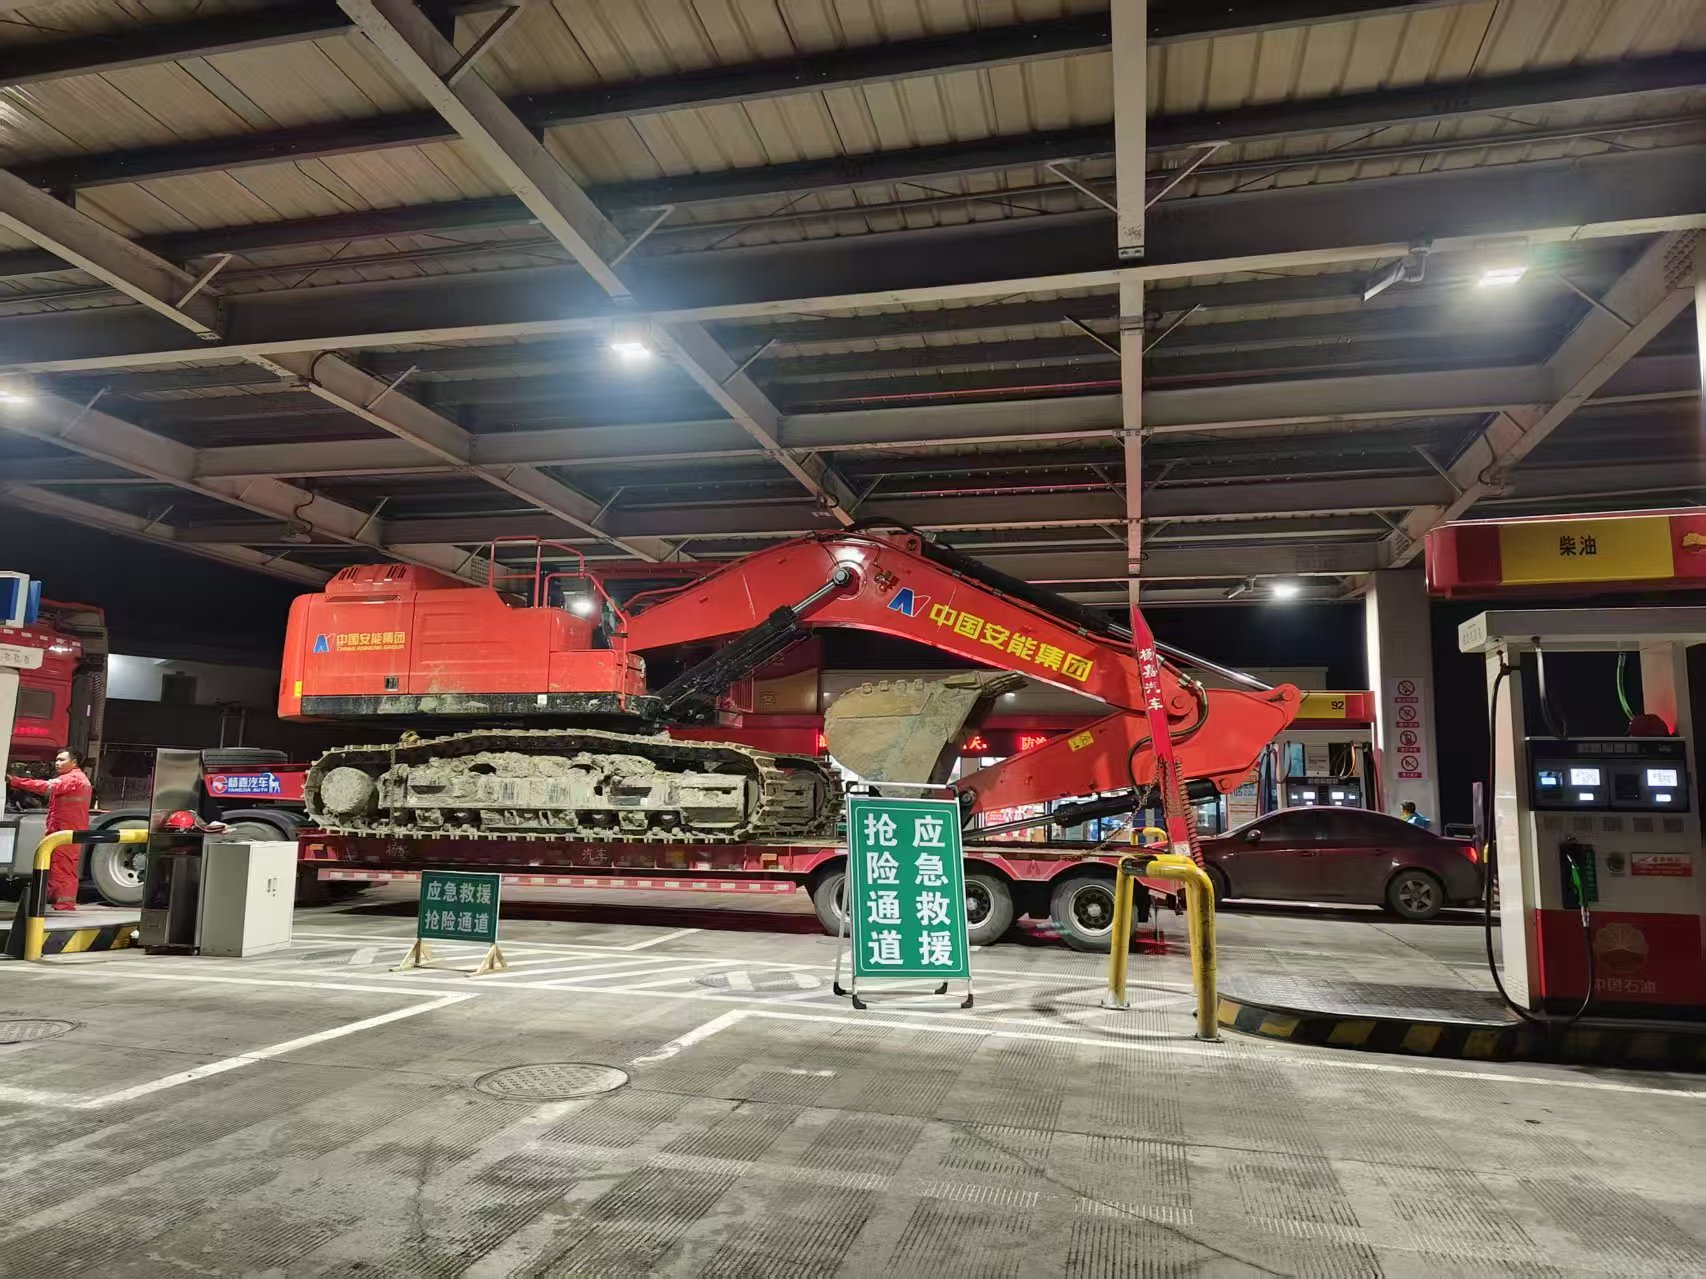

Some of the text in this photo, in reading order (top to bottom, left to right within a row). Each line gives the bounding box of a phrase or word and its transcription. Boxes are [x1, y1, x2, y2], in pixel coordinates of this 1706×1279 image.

[1559, 535, 1597, 557] 柴油
[336, 631, 405, 646] 中国安能集团
[929, 604, 1094, 683] 中国安能集团
[1331, 700, 1345, 711] 92
[426, 880, 491, 905] 应急救援
[864, 812, 904, 966] 抢险通道
[912, 815, 954, 967] 应急救援
[425, 909, 489, 934] 抢险通道
